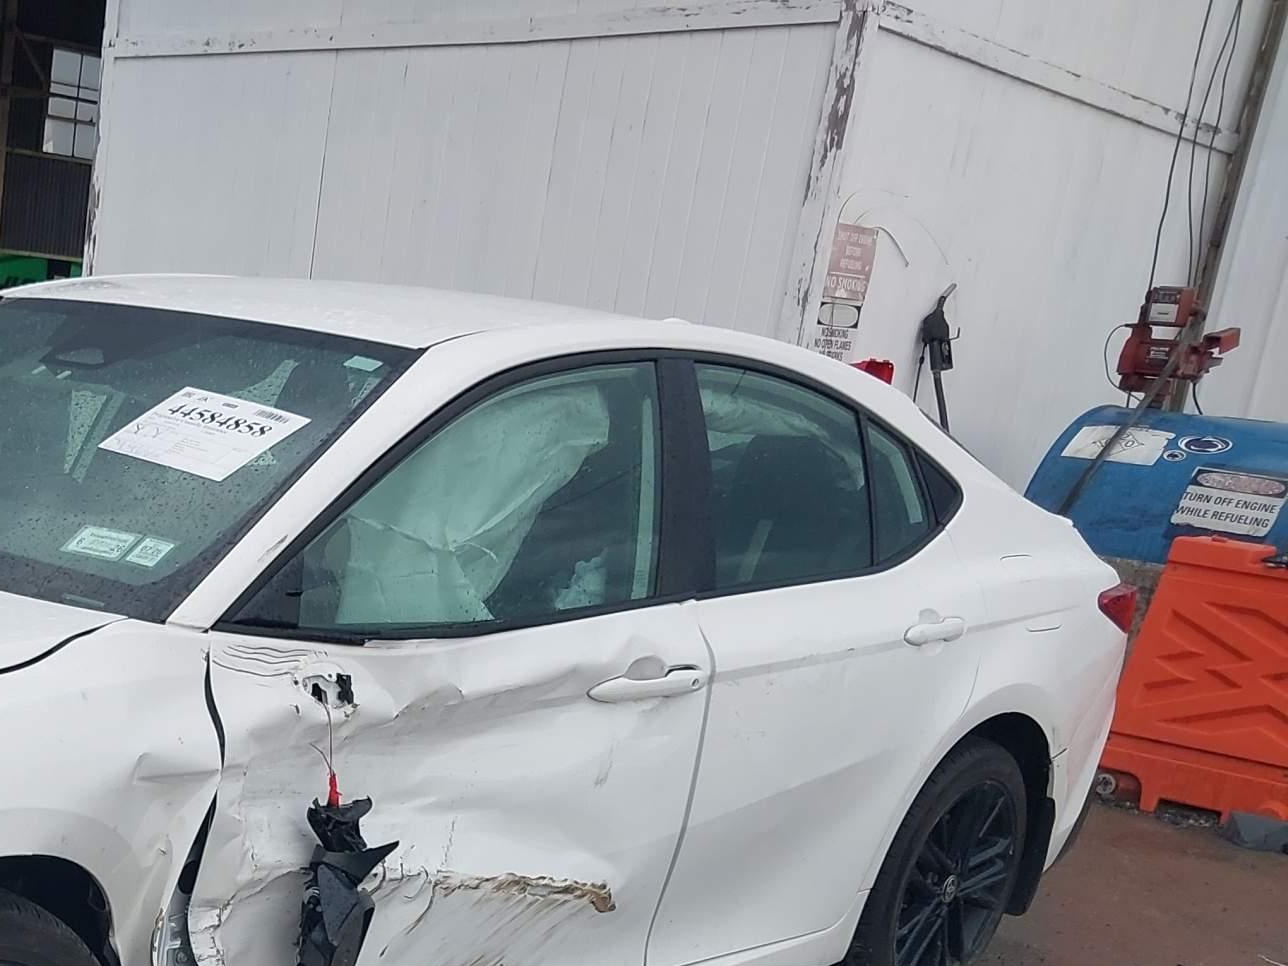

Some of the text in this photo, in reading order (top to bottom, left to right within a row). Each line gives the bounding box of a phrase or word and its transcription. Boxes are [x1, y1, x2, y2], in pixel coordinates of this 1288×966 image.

[826, 275, 867, 292] NO SMOKING
[167, 403, 273, 439] 44584858
[1183, 491, 1279, 514] TURN OFF ENGINE
[1176, 505, 1270, 528] WHILE REFUELING
